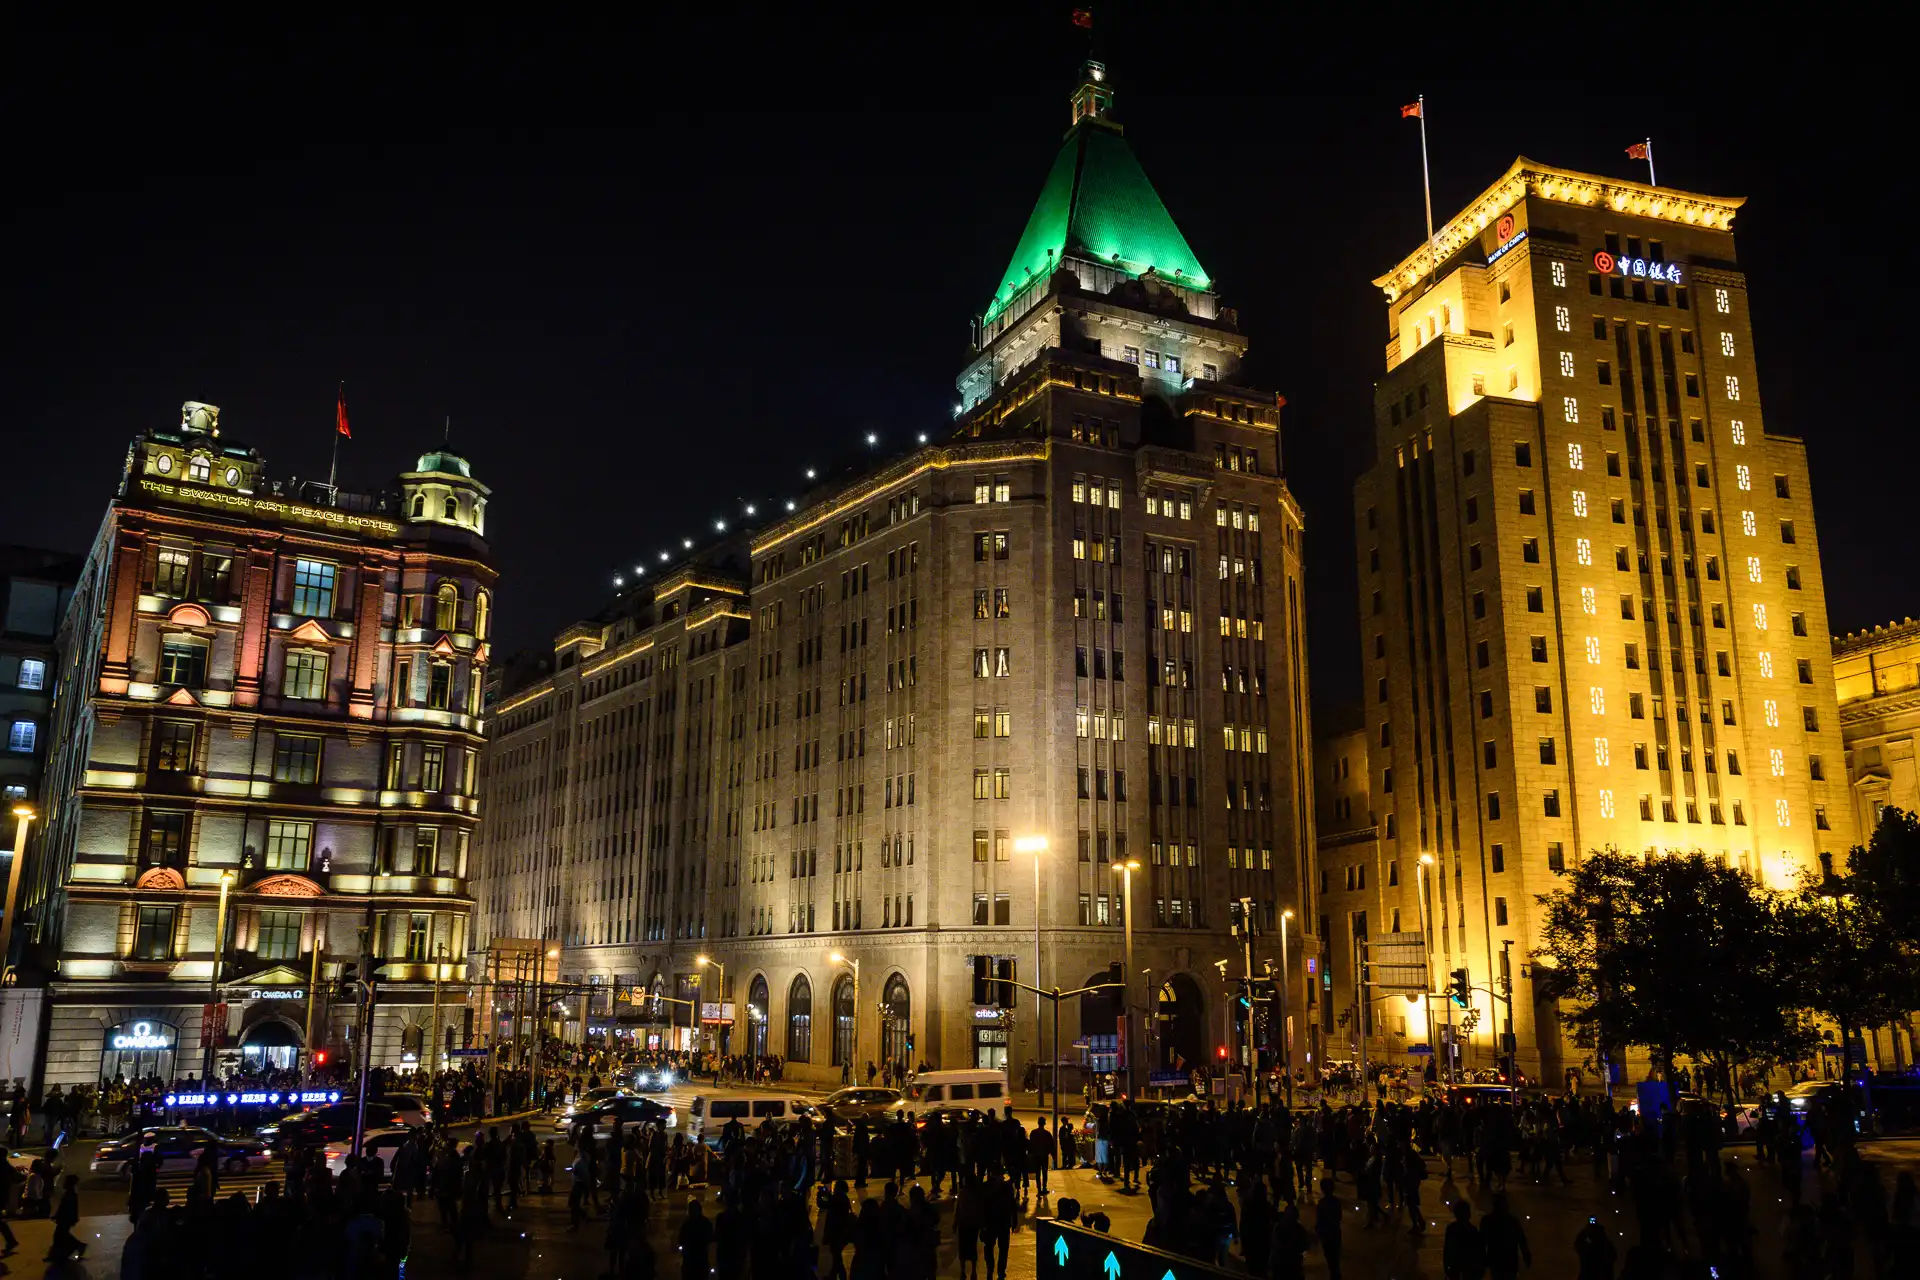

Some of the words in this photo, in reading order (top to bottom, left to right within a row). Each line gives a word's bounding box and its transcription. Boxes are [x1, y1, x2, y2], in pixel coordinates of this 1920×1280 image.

[1488, 249, 1503, 264] BANK
[1508, 231, 1527, 248] CHINA
[1617, 255, 1683, 284] 中国银行
[140, 479, 174, 495] THE
[179, 487, 250, 507] SWATCH
[254, 501, 289, 514] ART
[291, 505, 345, 524] PEACE
[348, 515, 398, 533] HOTEL
[262, 990, 293, 999] OMEGA
[113, 1036, 168, 1049] OMEGA
